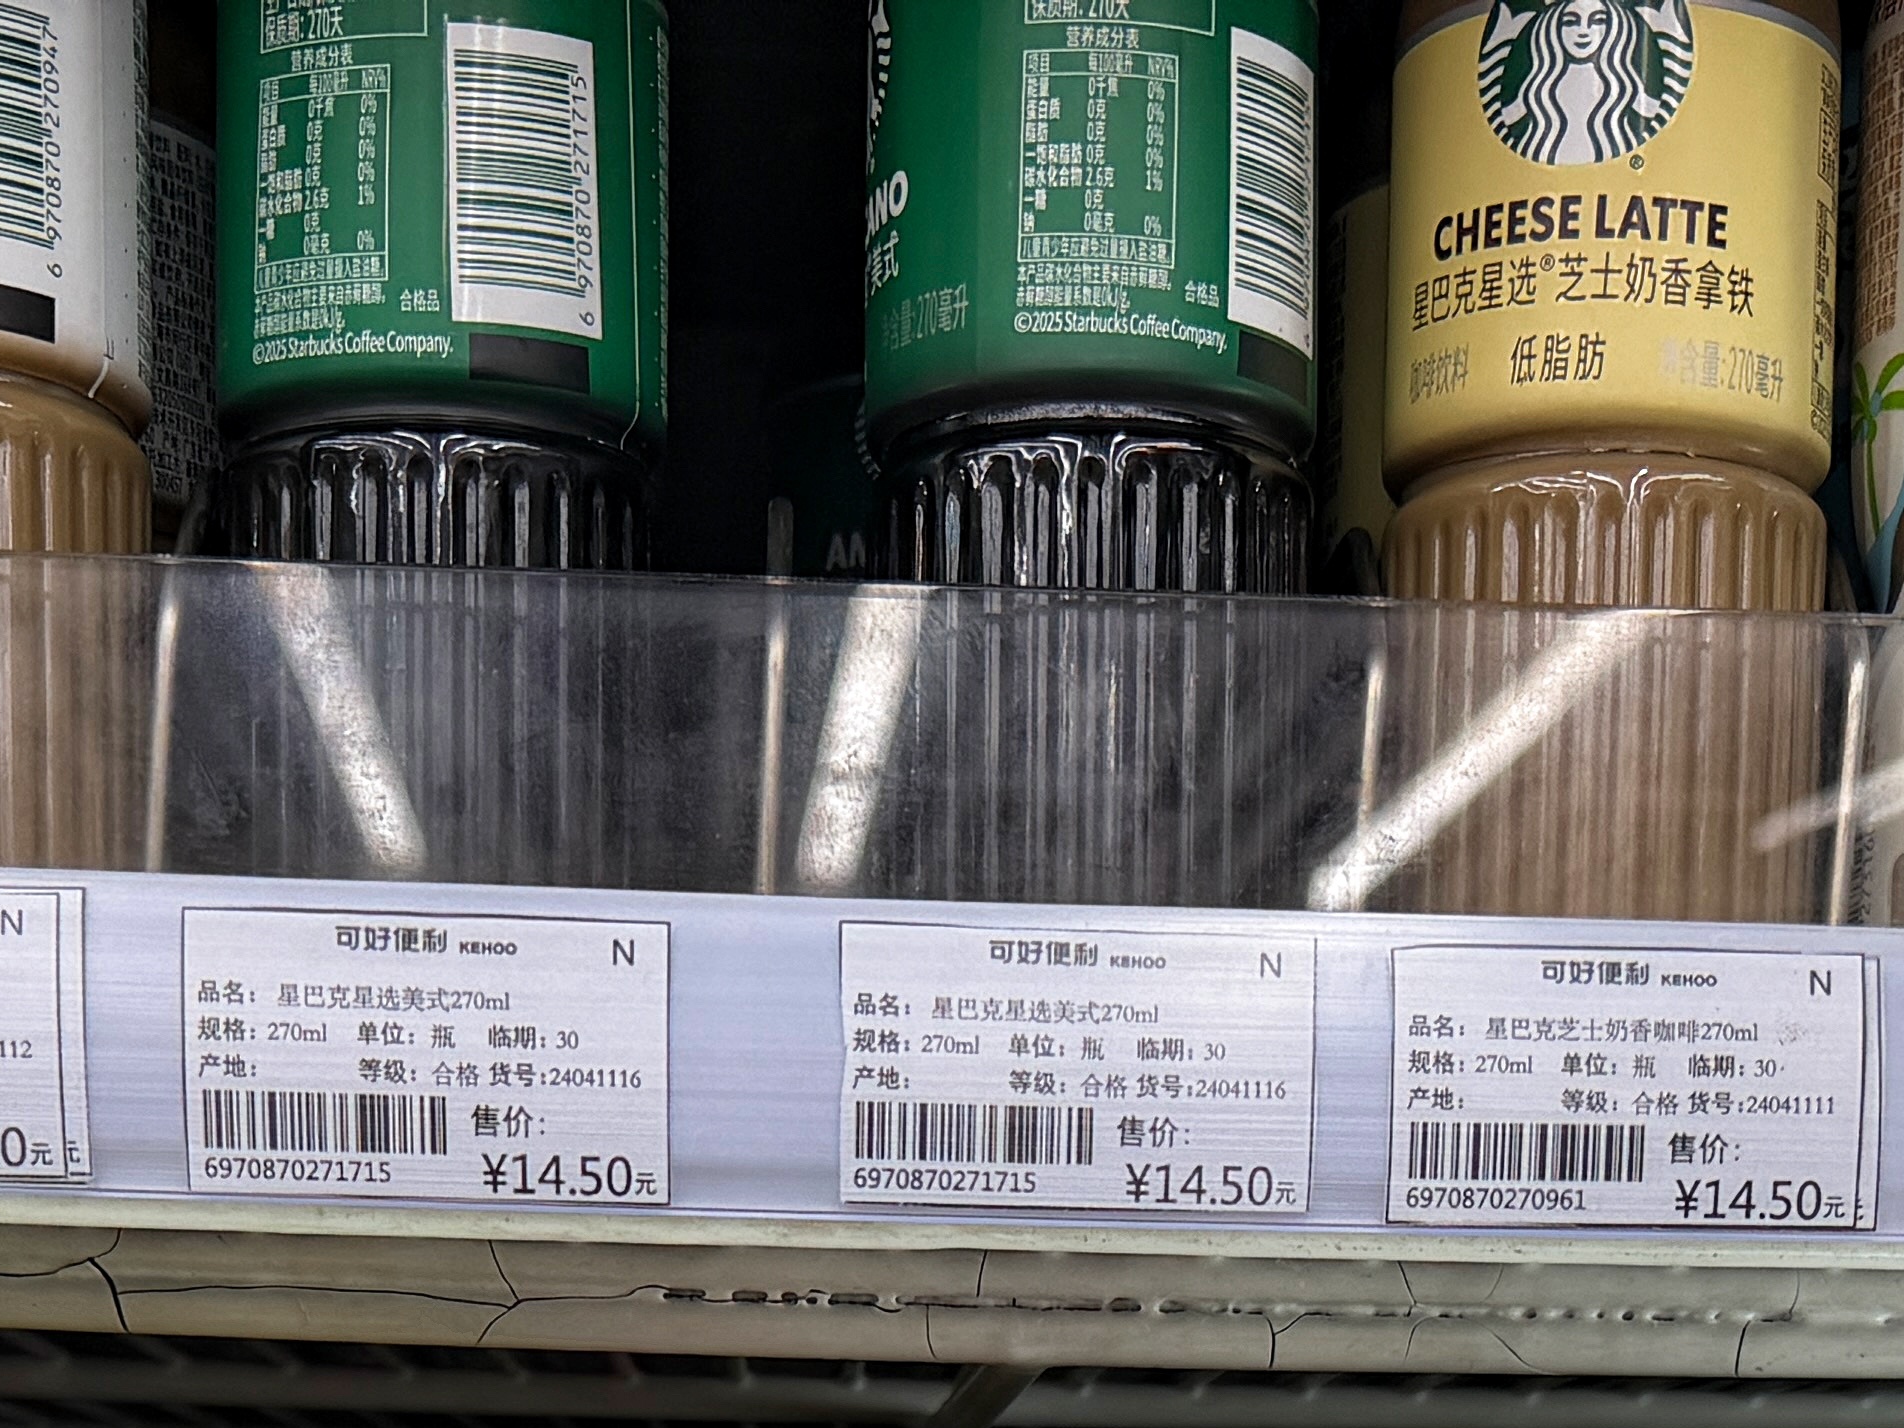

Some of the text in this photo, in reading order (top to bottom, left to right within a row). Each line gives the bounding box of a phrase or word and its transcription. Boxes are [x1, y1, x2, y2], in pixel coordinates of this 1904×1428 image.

[1066, 27, 1140, 50] 营养成分表
[1434, 194, 1728, 261] CHEESE LATTE
[1065, 312, 1129, 336] Starbucks
[1130, 313, 1170, 340] Coffee
[1510, 332, 1606, 386] 低脂肪
[1541, 959, 1650, 986] 可好便利
[204, 1157, 392, 1183] 6970870271715
[481, 1153, 657, 1197] ¥14.50元
[1124, 1162, 1297, 1206] ¥14.50元
[1405, 1186, 1586, 1212] 6970870270961
[1674, 1179, 1846, 1221] ¥14.50元
